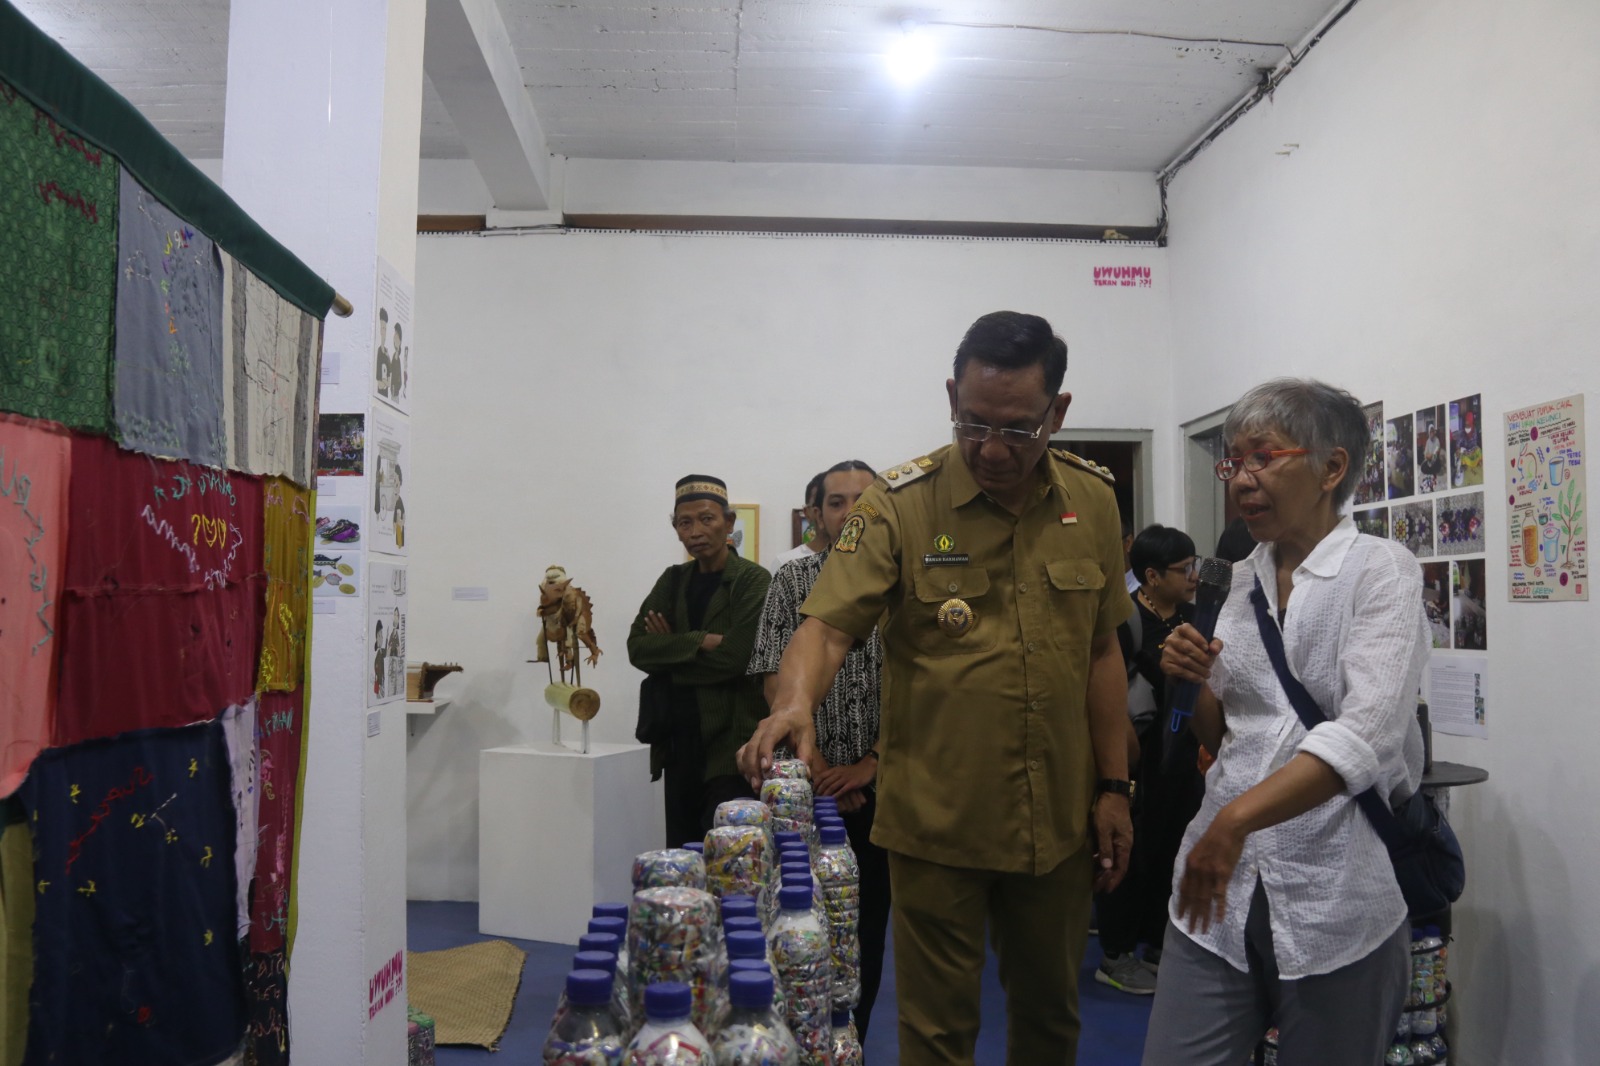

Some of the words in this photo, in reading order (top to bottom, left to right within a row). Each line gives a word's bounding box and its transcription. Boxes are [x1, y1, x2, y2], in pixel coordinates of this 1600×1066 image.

[1093, 266, 1151, 279] UWUHMU
[1507, 410, 1535, 422] MEMBUAT
[1536, 412, 1561, 425] KELINCI
[369, 950, 403, 1004] UWUHMU
